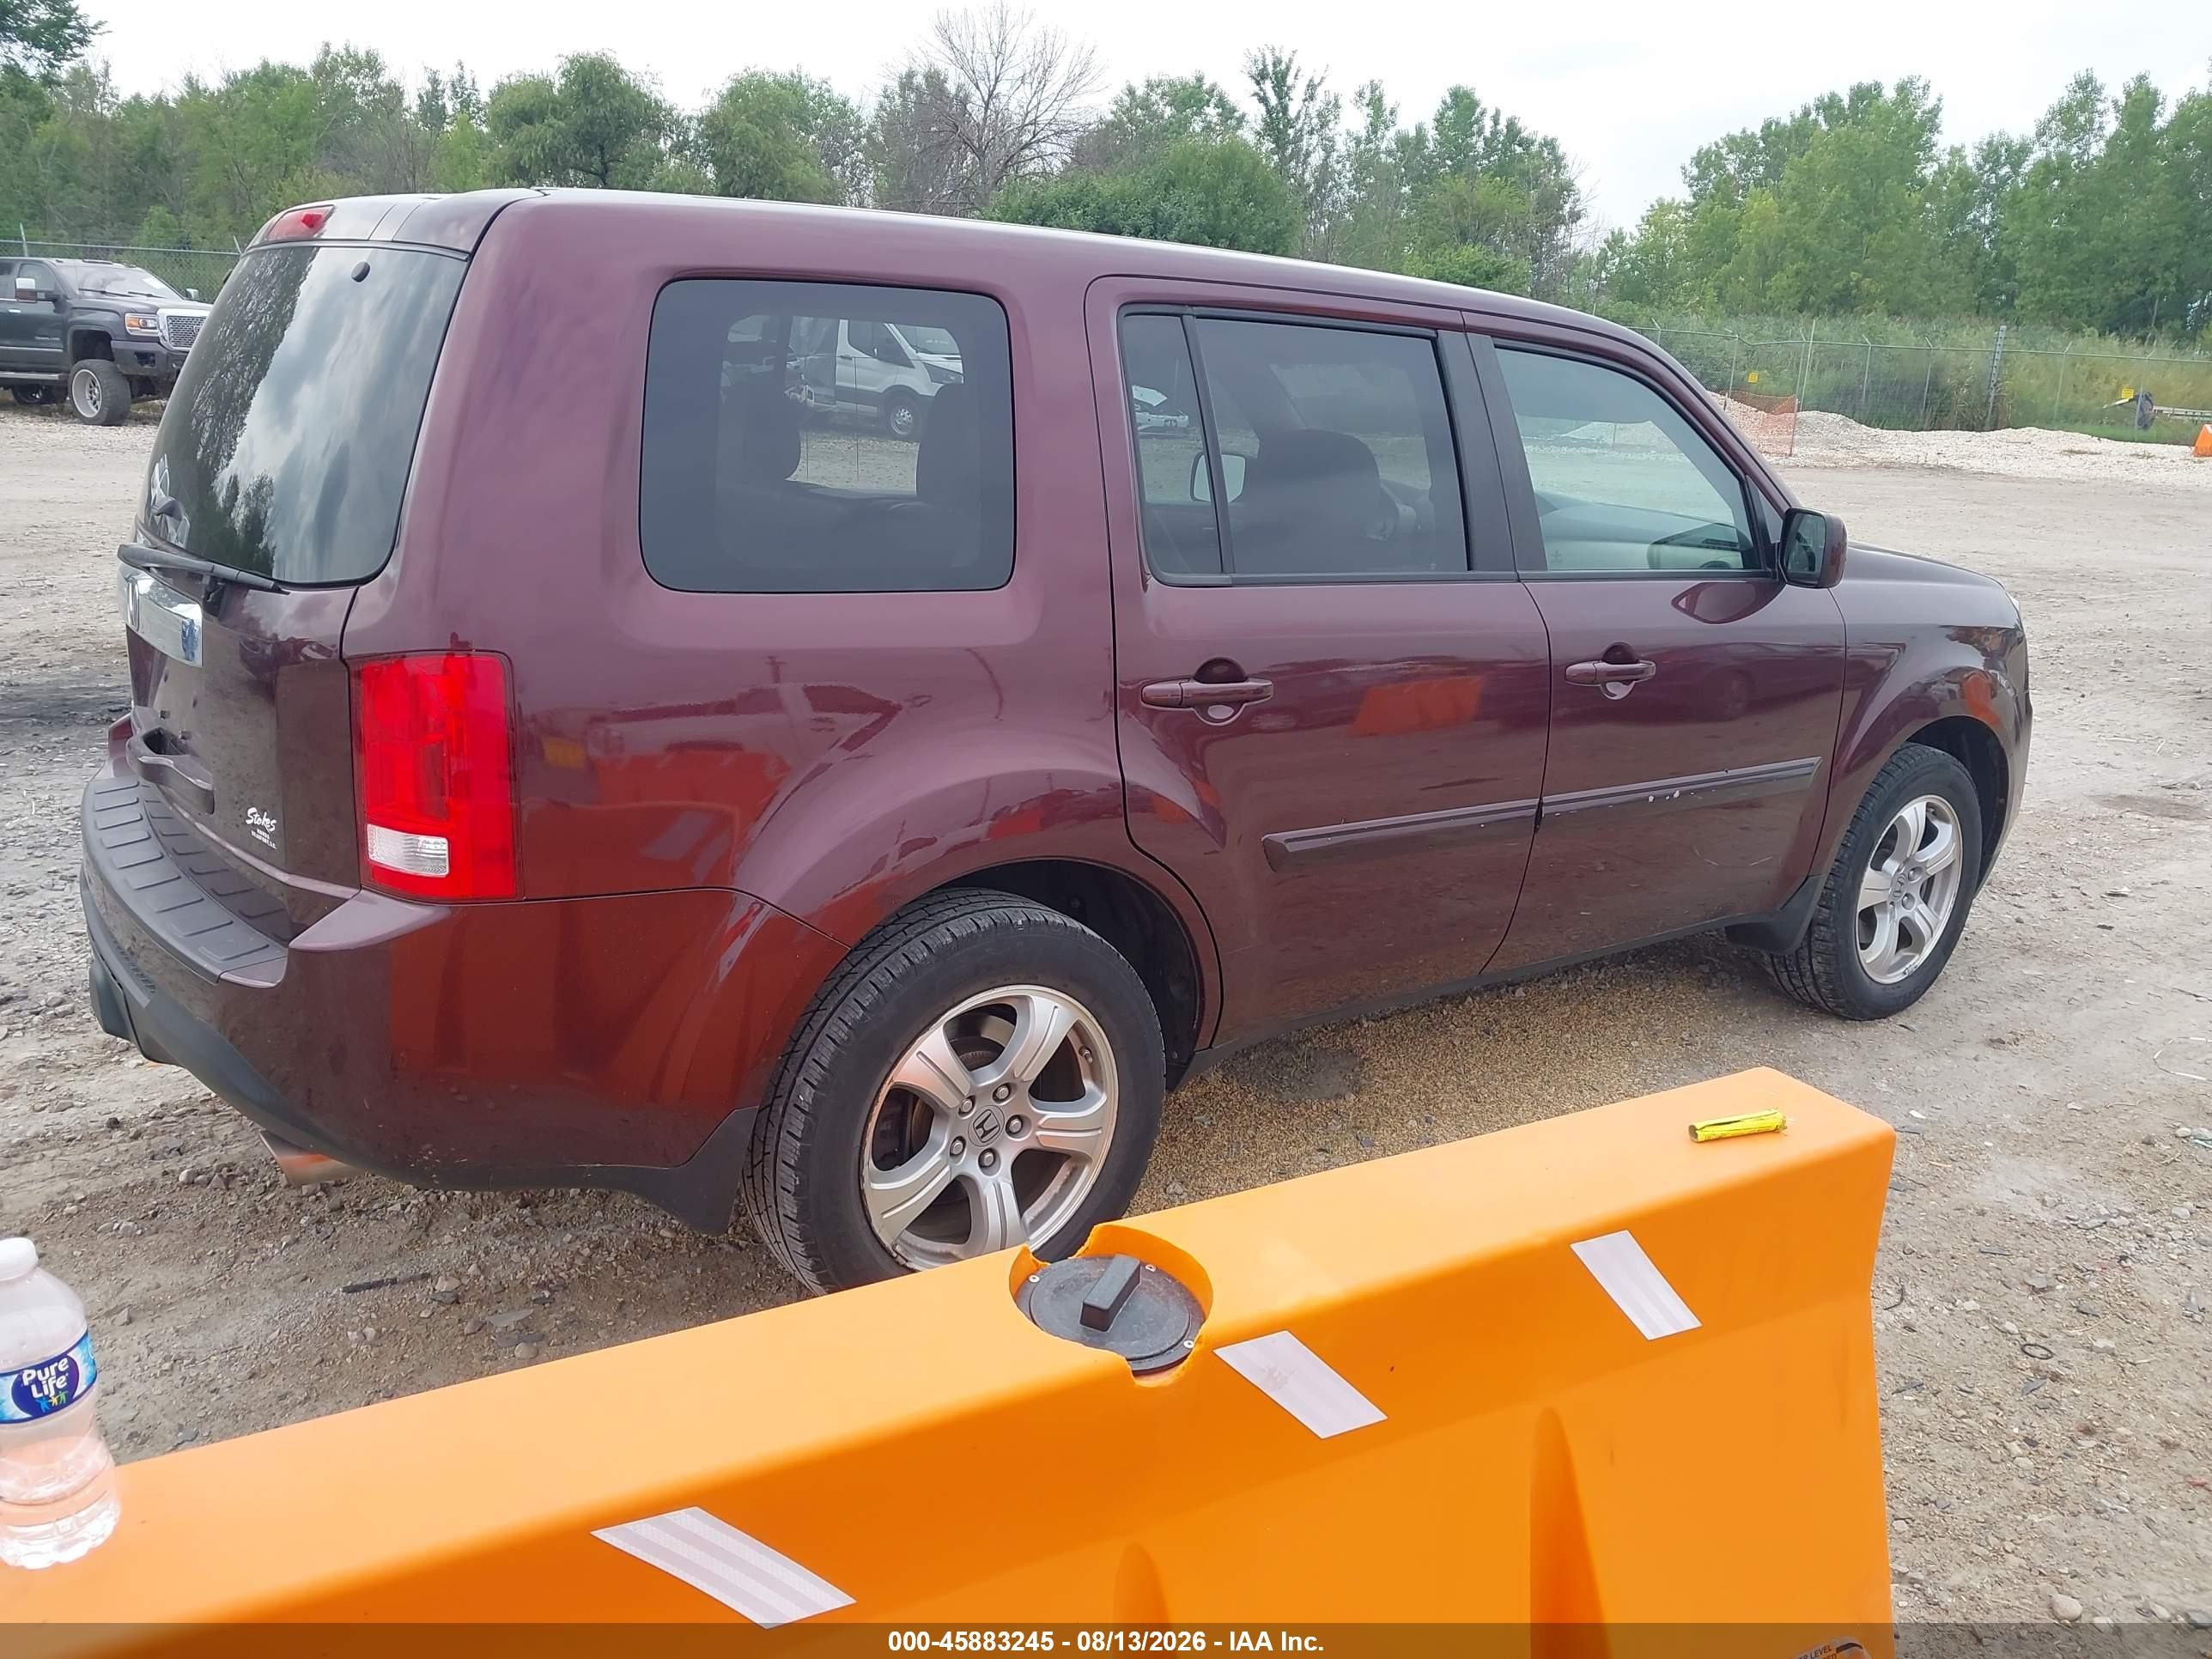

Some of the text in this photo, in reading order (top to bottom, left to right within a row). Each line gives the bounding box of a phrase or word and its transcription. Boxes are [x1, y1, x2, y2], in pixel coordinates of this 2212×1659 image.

[245, 807, 276, 833] Stokes
[21, 1357, 69, 1386] Pure
[30, 1376, 68, 1399] Life
[1809, 1644, 1832, 1659] LEVEL
